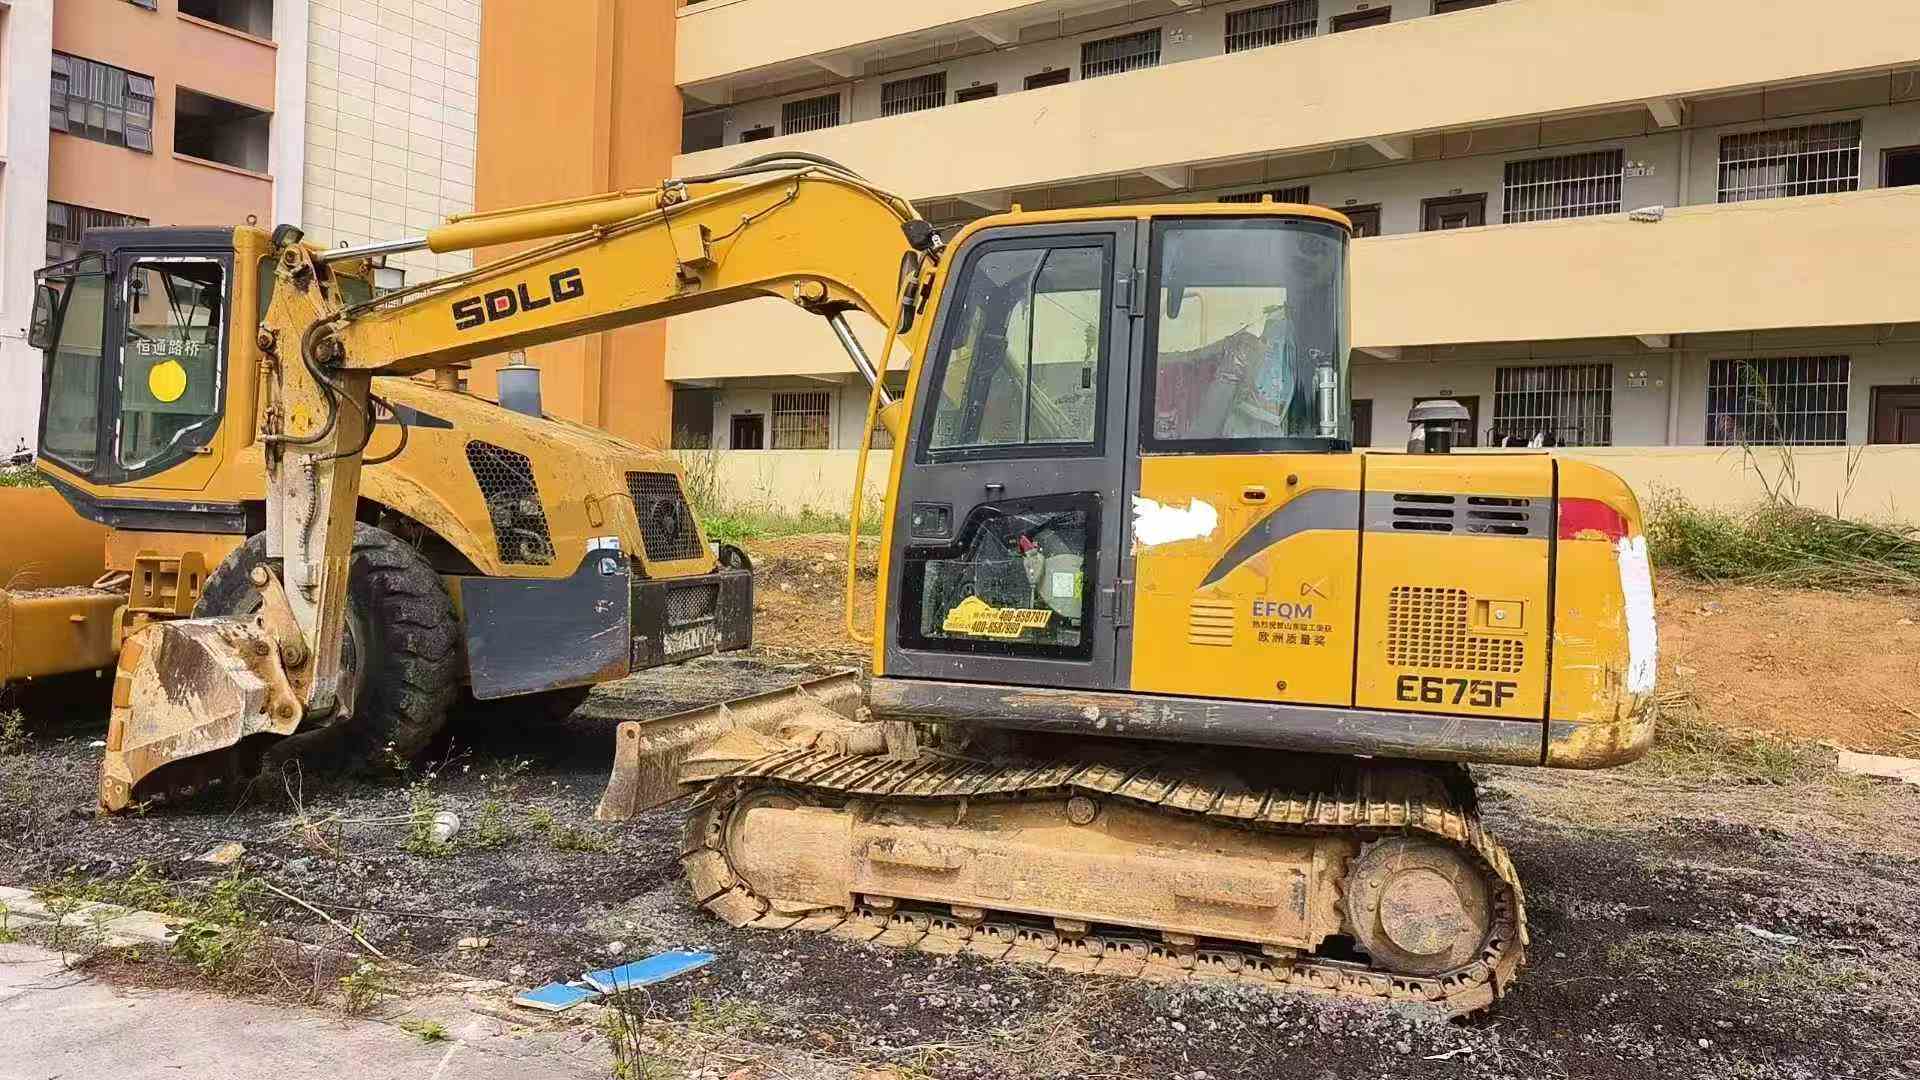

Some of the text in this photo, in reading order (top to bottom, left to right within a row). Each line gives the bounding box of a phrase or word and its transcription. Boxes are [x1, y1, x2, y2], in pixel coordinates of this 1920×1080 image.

[452, 267, 584, 331] SDLG
[137, 338, 200, 356] 恒通路桥
[1253, 601, 1313, 619] EFQM
[1258, 632, 1326, 646] 欧洲质量奖
[1397, 674, 1518, 708] E675F
